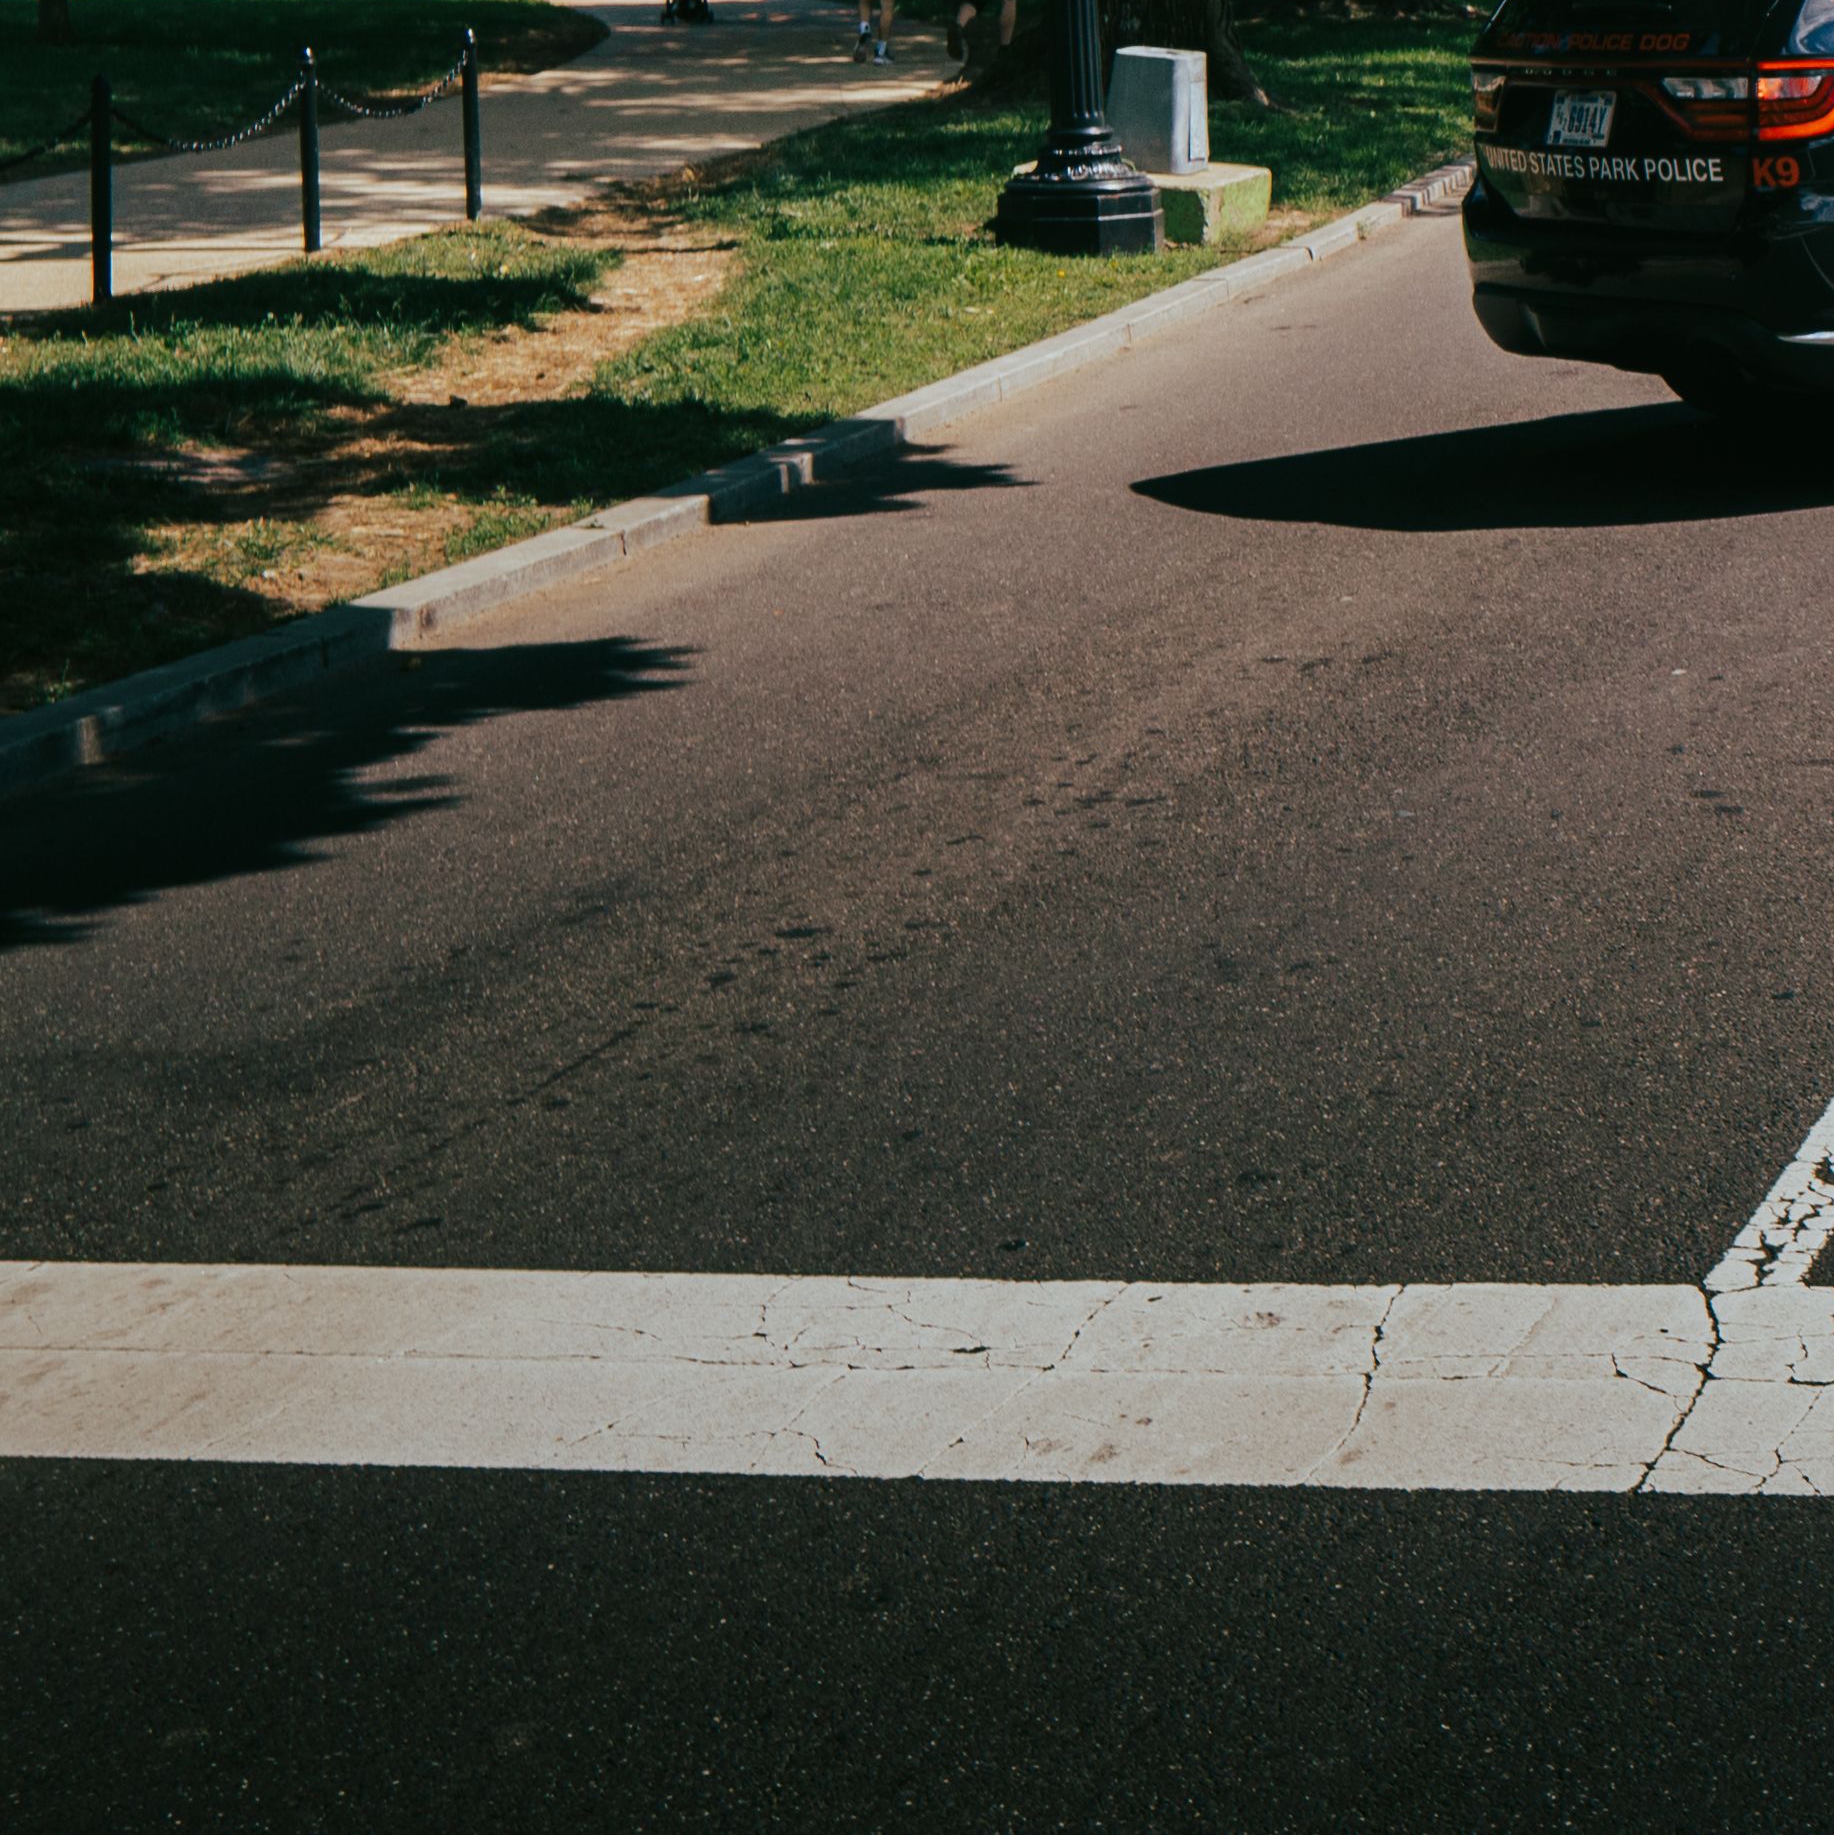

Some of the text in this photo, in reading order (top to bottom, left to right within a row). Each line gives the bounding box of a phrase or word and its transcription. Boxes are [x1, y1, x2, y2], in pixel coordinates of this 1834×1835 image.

[1567, 32, 1634, 51] POLICE
[1639, 33, 1691, 52] DOG
[1485, 148, 1725, 183] UNITED STATES PARK POLICE
[1752, 156, 1801, 188] K9
